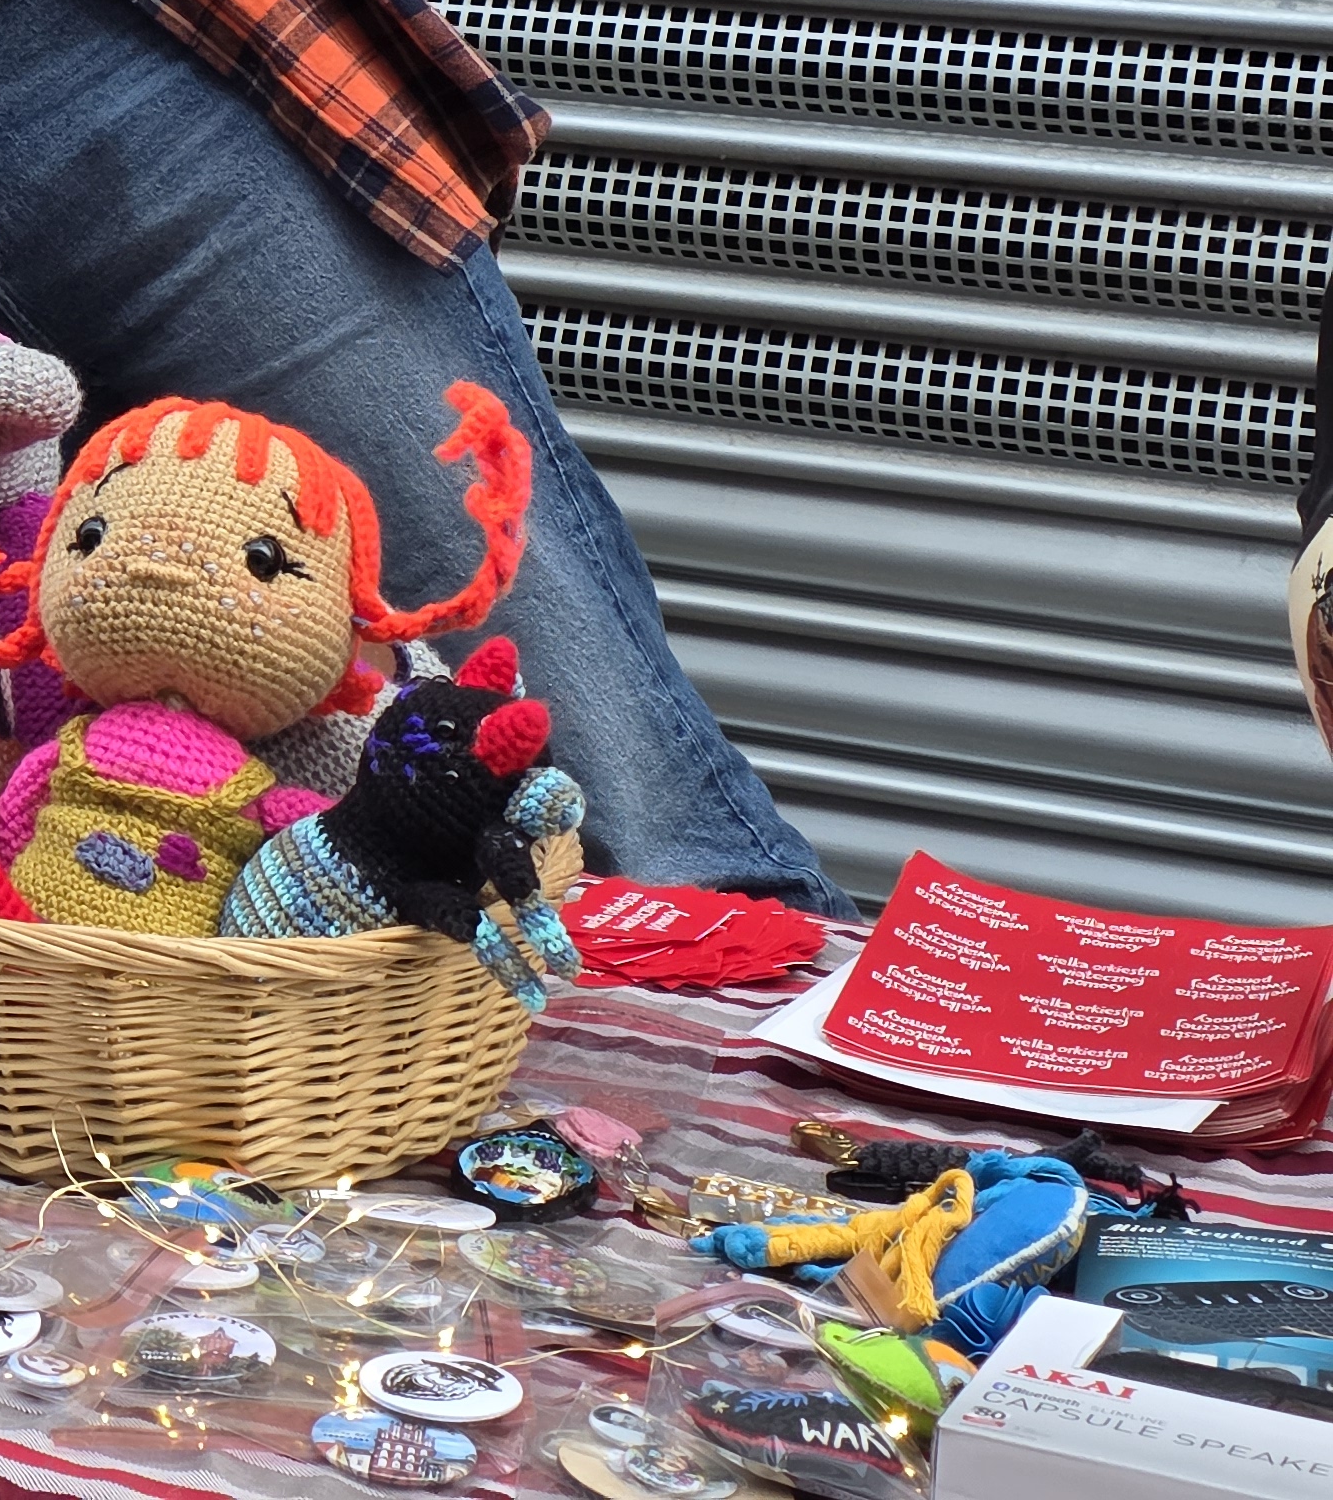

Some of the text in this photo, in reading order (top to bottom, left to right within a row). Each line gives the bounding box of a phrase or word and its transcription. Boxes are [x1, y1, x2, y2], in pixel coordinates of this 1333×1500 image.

[945, 883, 1006, 909] pomocy
[915, 886, 1029, 931] wielka orkiestra
[925, 923, 987, 950] pomocy
[1056, 913, 1175, 937] wielka orkiestra
[894, 927, 1010, 973] wielka orkiestra
[1080, 937, 1144, 953] pomocy
[1221, 934, 1286, 946] pomocy
[1037, 953, 1160, 977] wielka orkiestra
[1190, 948, 1313, 964] wielka orkiestra
[904, 965, 967, 991] pomocy
[1063, 977, 1128, 993] pomocy
[1208, 973, 1273, 984] pomocy
[872, 970, 992, 1013] wielka orkiestra
[1175, 986, 1300, 1003] wielka orkiestra
[1019, 993, 1144, 1018] wielka orkiestra
[881, 1009, 947, 1034] pomocy
[1044, 1017, 1111, 1034] pomocy
[1193, 1012, 1260, 1024] pomocy
[848, 1015, 972, 1057] wielka orkiestra
[1161, 1022, 1286, 1042] wielka orkiestra
[1000, 1035, 1129, 1059] wielka orkiestra
[1178, 1050, 1246, 1064] pomocy
[1025, 1059, 1095, 1076] pomocy
[1144, 1060, 1273, 1083] wielka orkiestra
[1102, 1223, 1308, 1247] Mini Keyboard
[1005, 1364, 1139, 1400] AKAI
[1011, 1385, 1081, 1408] Bluetooth
[981, 1390, 1165, 1439] CAPSULE
[1090, 1405, 1168, 1428] SLIMLINE
